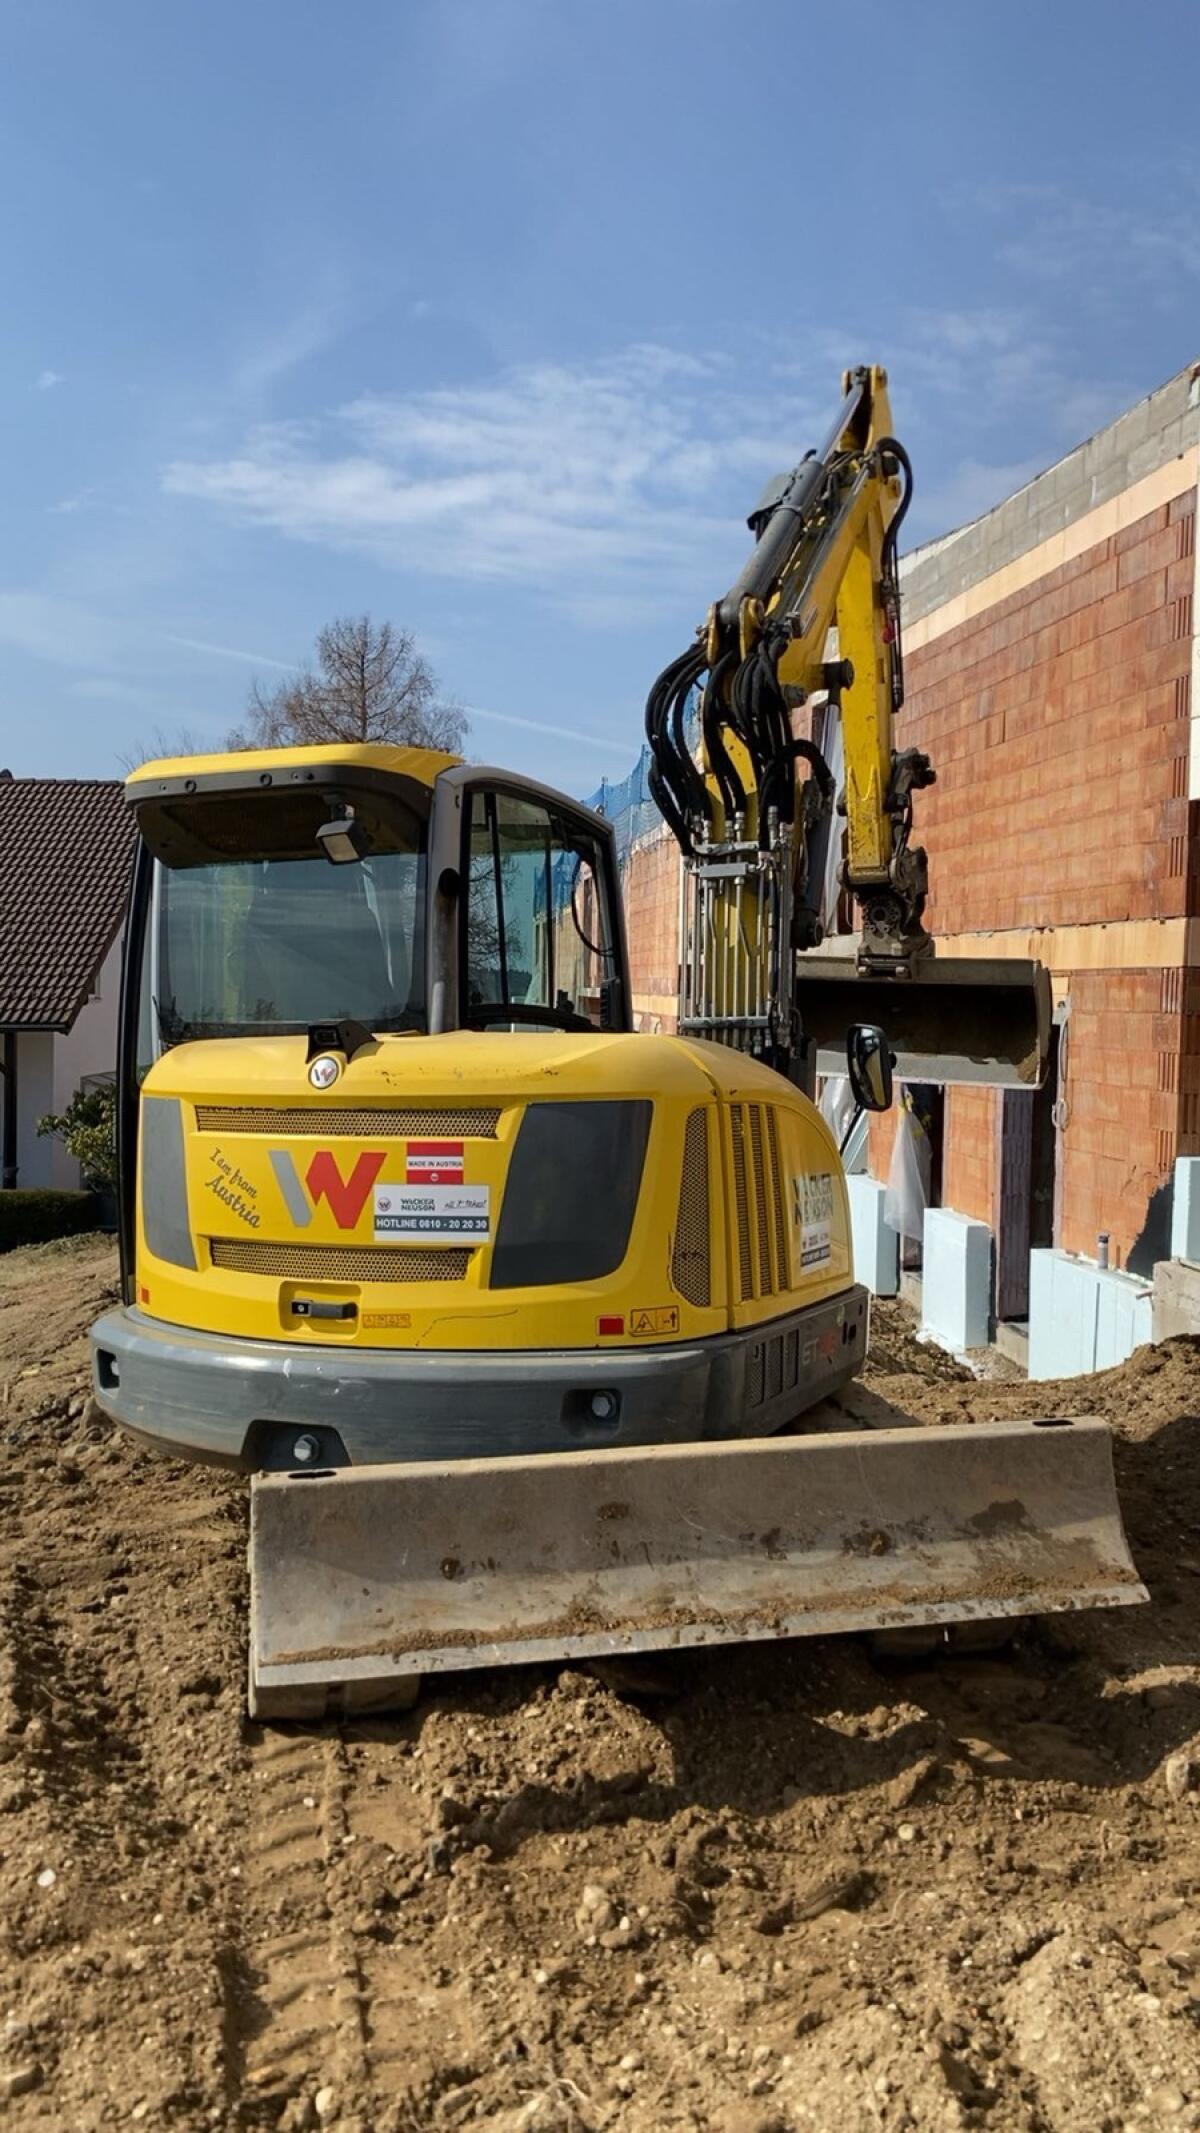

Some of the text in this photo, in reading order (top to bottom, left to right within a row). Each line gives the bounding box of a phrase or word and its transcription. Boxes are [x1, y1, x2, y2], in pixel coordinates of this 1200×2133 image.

[209, 1147, 258, 1199] I am from
[408, 1160, 464, 1168] MADE IN AUSTRIA
[205, 1175, 260, 1229] Austria
[376, 1219, 417, 1229] HOTLINE
[449, 1220, 460, 1229] 20
[462, 1220, 473, 1229] 20
[474, 1220, 487, 1229] 30
